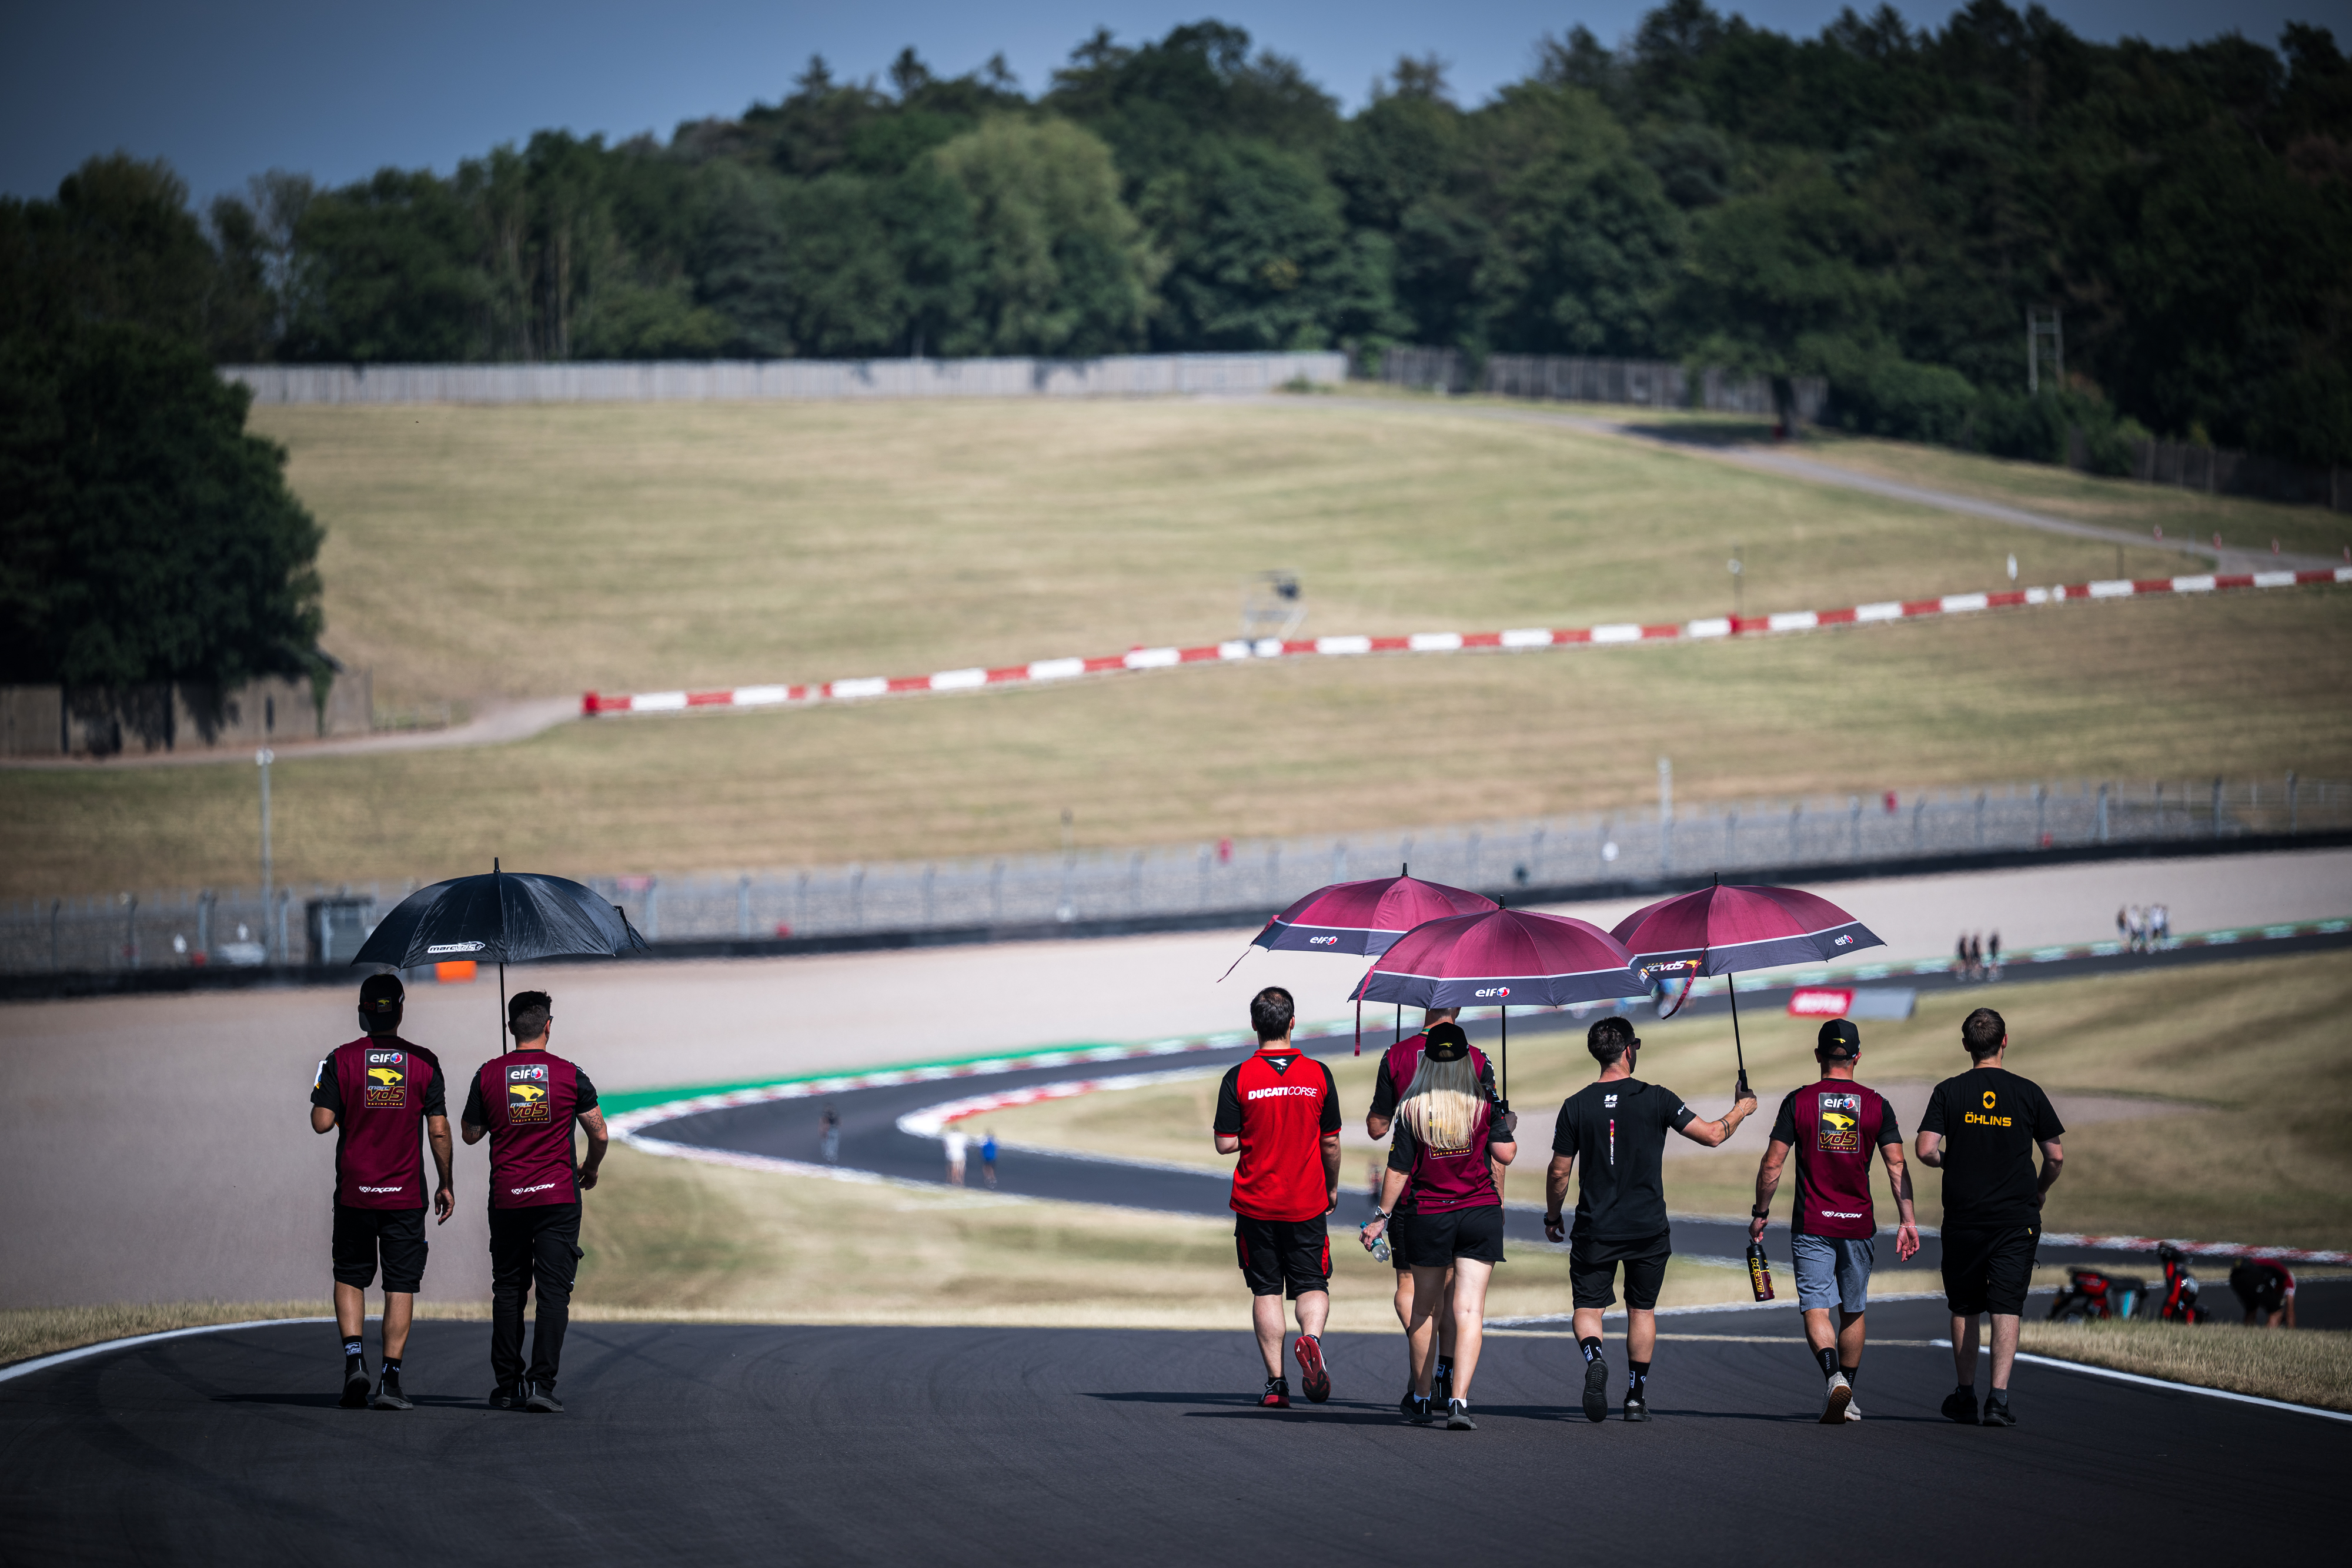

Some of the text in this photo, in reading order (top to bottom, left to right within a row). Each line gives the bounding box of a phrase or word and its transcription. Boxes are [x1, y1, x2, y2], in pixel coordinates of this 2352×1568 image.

[1309, 936, 1329, 944] elf
[1835, 937, 1846, 946] elf
[1475, 988, 1497, 997] elf
[369, 1054, 390, 1063] elf
[510, 1069, 531, 1079] elf
[1824, 1098, 1843, 1108] elf
[1965, 1111, 2012, 1127] ÖHLINS
